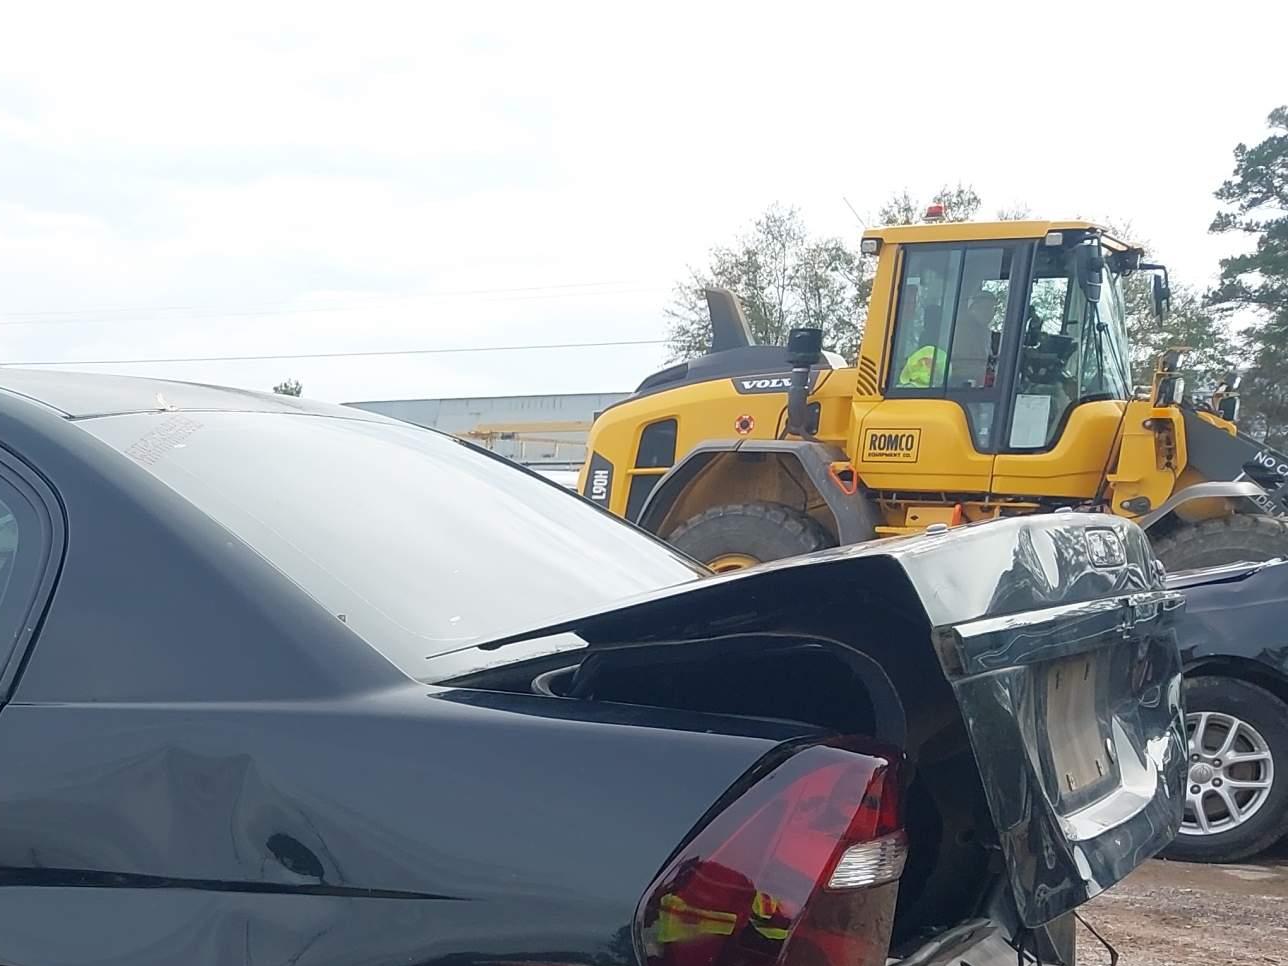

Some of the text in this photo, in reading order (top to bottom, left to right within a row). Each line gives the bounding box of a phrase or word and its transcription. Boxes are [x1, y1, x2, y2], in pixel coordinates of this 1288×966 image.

[741, 378, 792, 389] VOLV
[869, 433, 914, 451] ROMCO
[1254, 451, 1276, 468] NO
[591, 470, 608, 500] L90H
